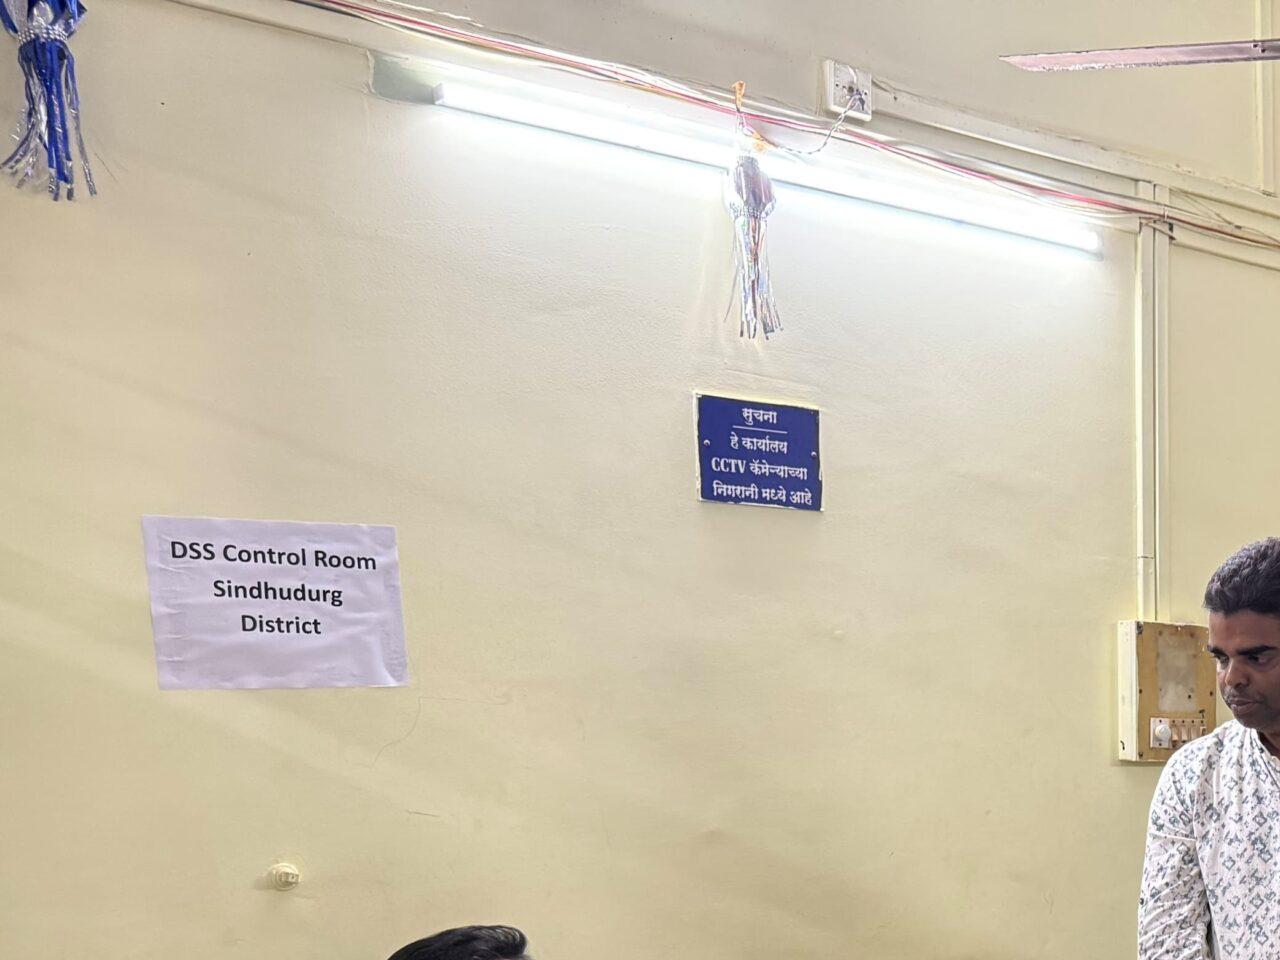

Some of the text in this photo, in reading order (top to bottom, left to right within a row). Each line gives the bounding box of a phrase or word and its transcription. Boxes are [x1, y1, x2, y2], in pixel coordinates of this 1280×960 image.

[742, 408, 777, 425] सुचना
[730, 432, 788, 454] हे कार्यालय
[711, 457, 746, 473] CCTV
[713, 480, 812, 505] निगरानी मध्ये आहे
[170, 541, 376, 570] DSS Control Room
[213, 580, 343, 607] Sindhudurg
[241, 615, 322, 635] District
